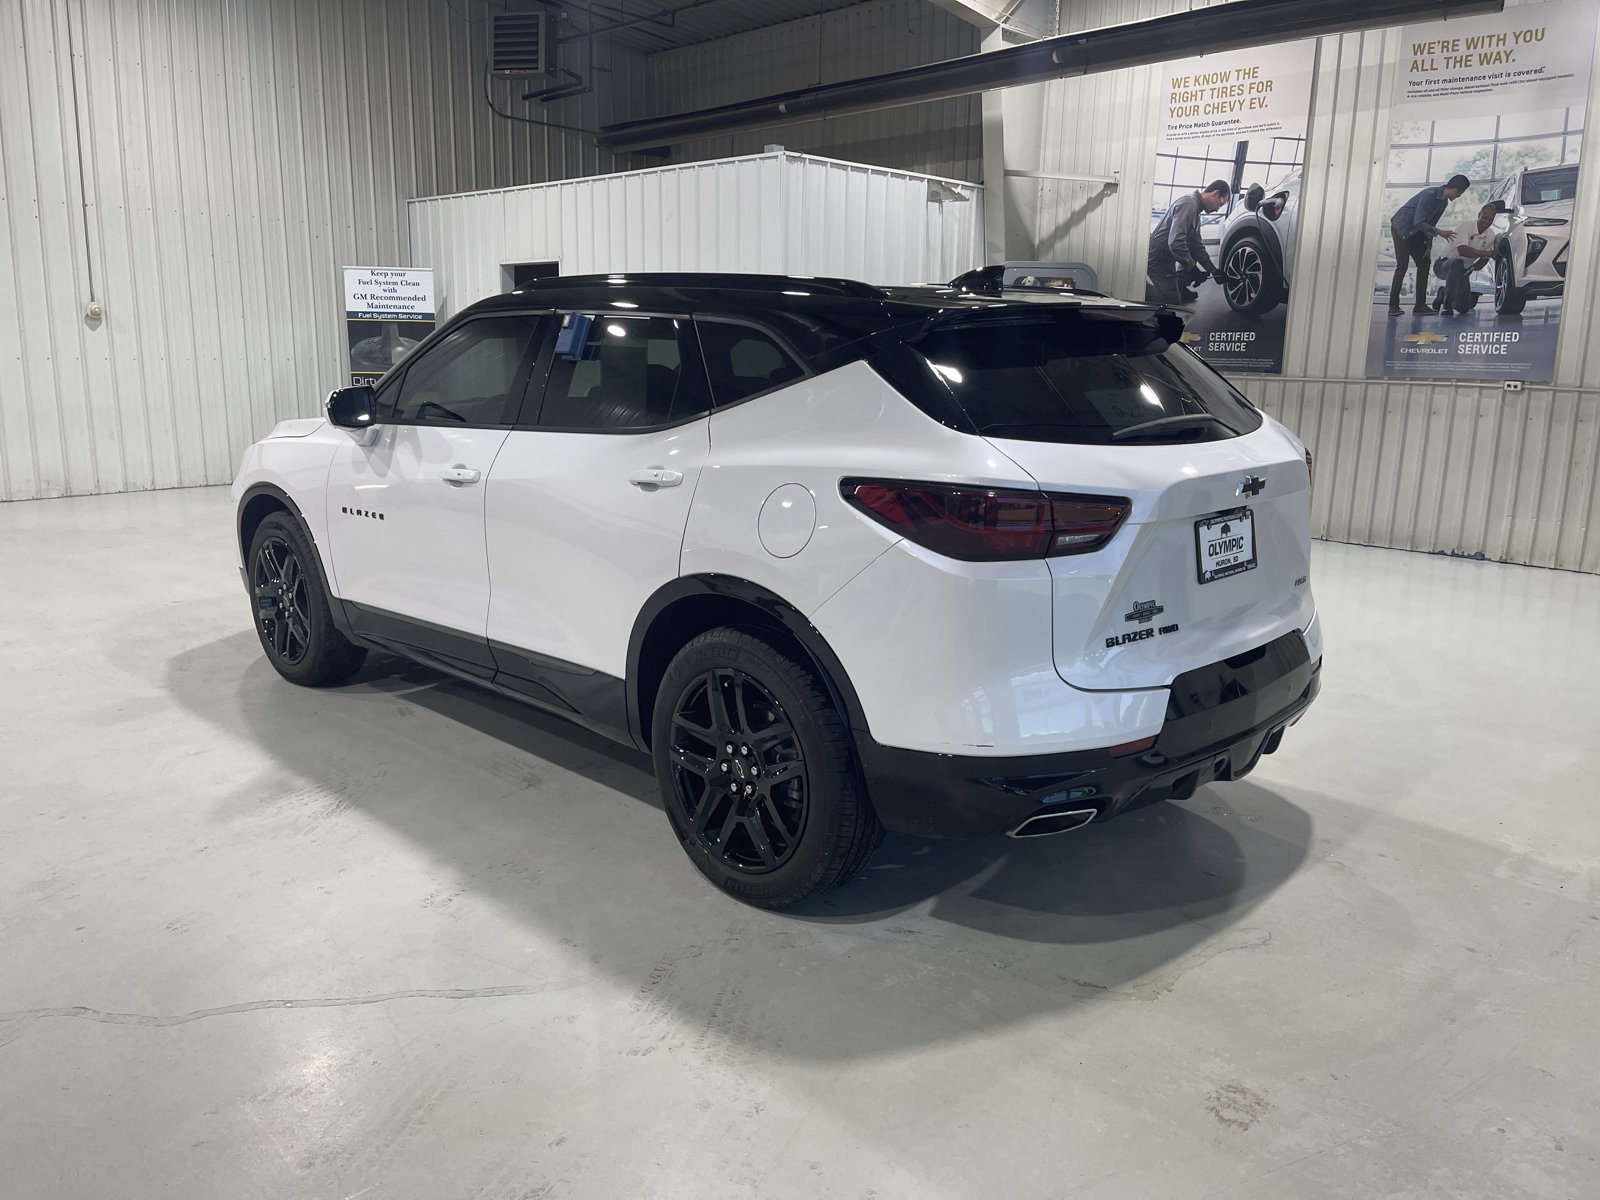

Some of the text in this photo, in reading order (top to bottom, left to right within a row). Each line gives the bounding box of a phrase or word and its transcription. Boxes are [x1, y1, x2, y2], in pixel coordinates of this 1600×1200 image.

[1412, 27, 1546, 56] WE'RE WITH YOU
[1410, 49, 1516, 73] ALL THE WAY.
[1171, 67, 1260, 89] WE KNOW THE
[1408, 80, 1423, 89] Your
[1441, 74, 1486, 84] maintenance
[1487, 72, 1503, 80] visit
[1170, 80, 1273, 104] RIGHT TIRES FOR
[1169, 96, 1268, 118] YOUR CHEVY EV.
[1211, 119, 1242, 127] Guarantee.
[370, 270, 389, 278] Keep
[374, 280, 399, 288] System
[370, 293, 427, 302] Recommended
[366, 302, 416, 310] Maintenance
[1209, 332, 1256, 341] CERTIFIED
[1459, 332, 1520, 343] CERTIFIED
[1208, 342, 1247, 352] SERVICE
[1457, 344, 1508, 355] SERVICE
[342, 506, 384, 520] BLAZER
[1208, 536, 1244, 557] OLYMPIC
[1105, 628, 1154, 648] BLAZER
